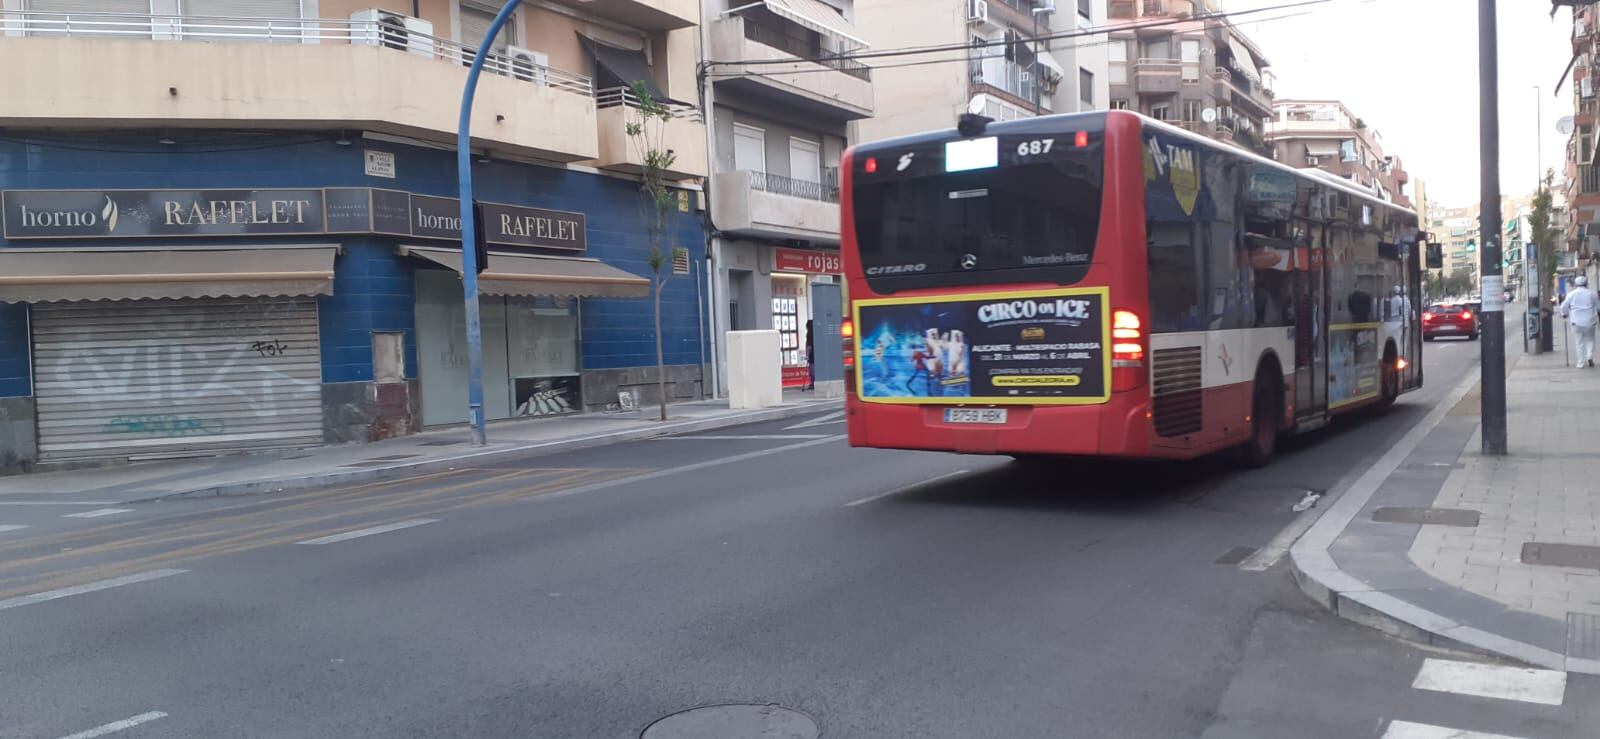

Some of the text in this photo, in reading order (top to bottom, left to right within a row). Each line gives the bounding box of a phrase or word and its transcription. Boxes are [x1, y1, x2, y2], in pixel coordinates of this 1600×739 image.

[1017, 138, 1055, 157] 687
[1166, 144, 1194, 172] TAM
[19, 204, 96, 227] horno
[163, 200, 310, 225] RAFELET
[417, 207, 463, 231] horno
[500, 213, 578, 240] RAFELET
[808, 253, 839, 272] rojas
[1022, 253, 1088, 265] Mercedes-Benz
[866, 263, 926, 275] CITARO
[977, 300, 1037, 322] CIRCO
[1055, 299, 1090, 319] ICE
[972, 344, 1012, 352] ALICANTE
[1016, 343, 1067, 351] MULTIESPACIO
[1068, 342, 1101, 350] RABASA
[1049, 352, 1056, 360] 6
